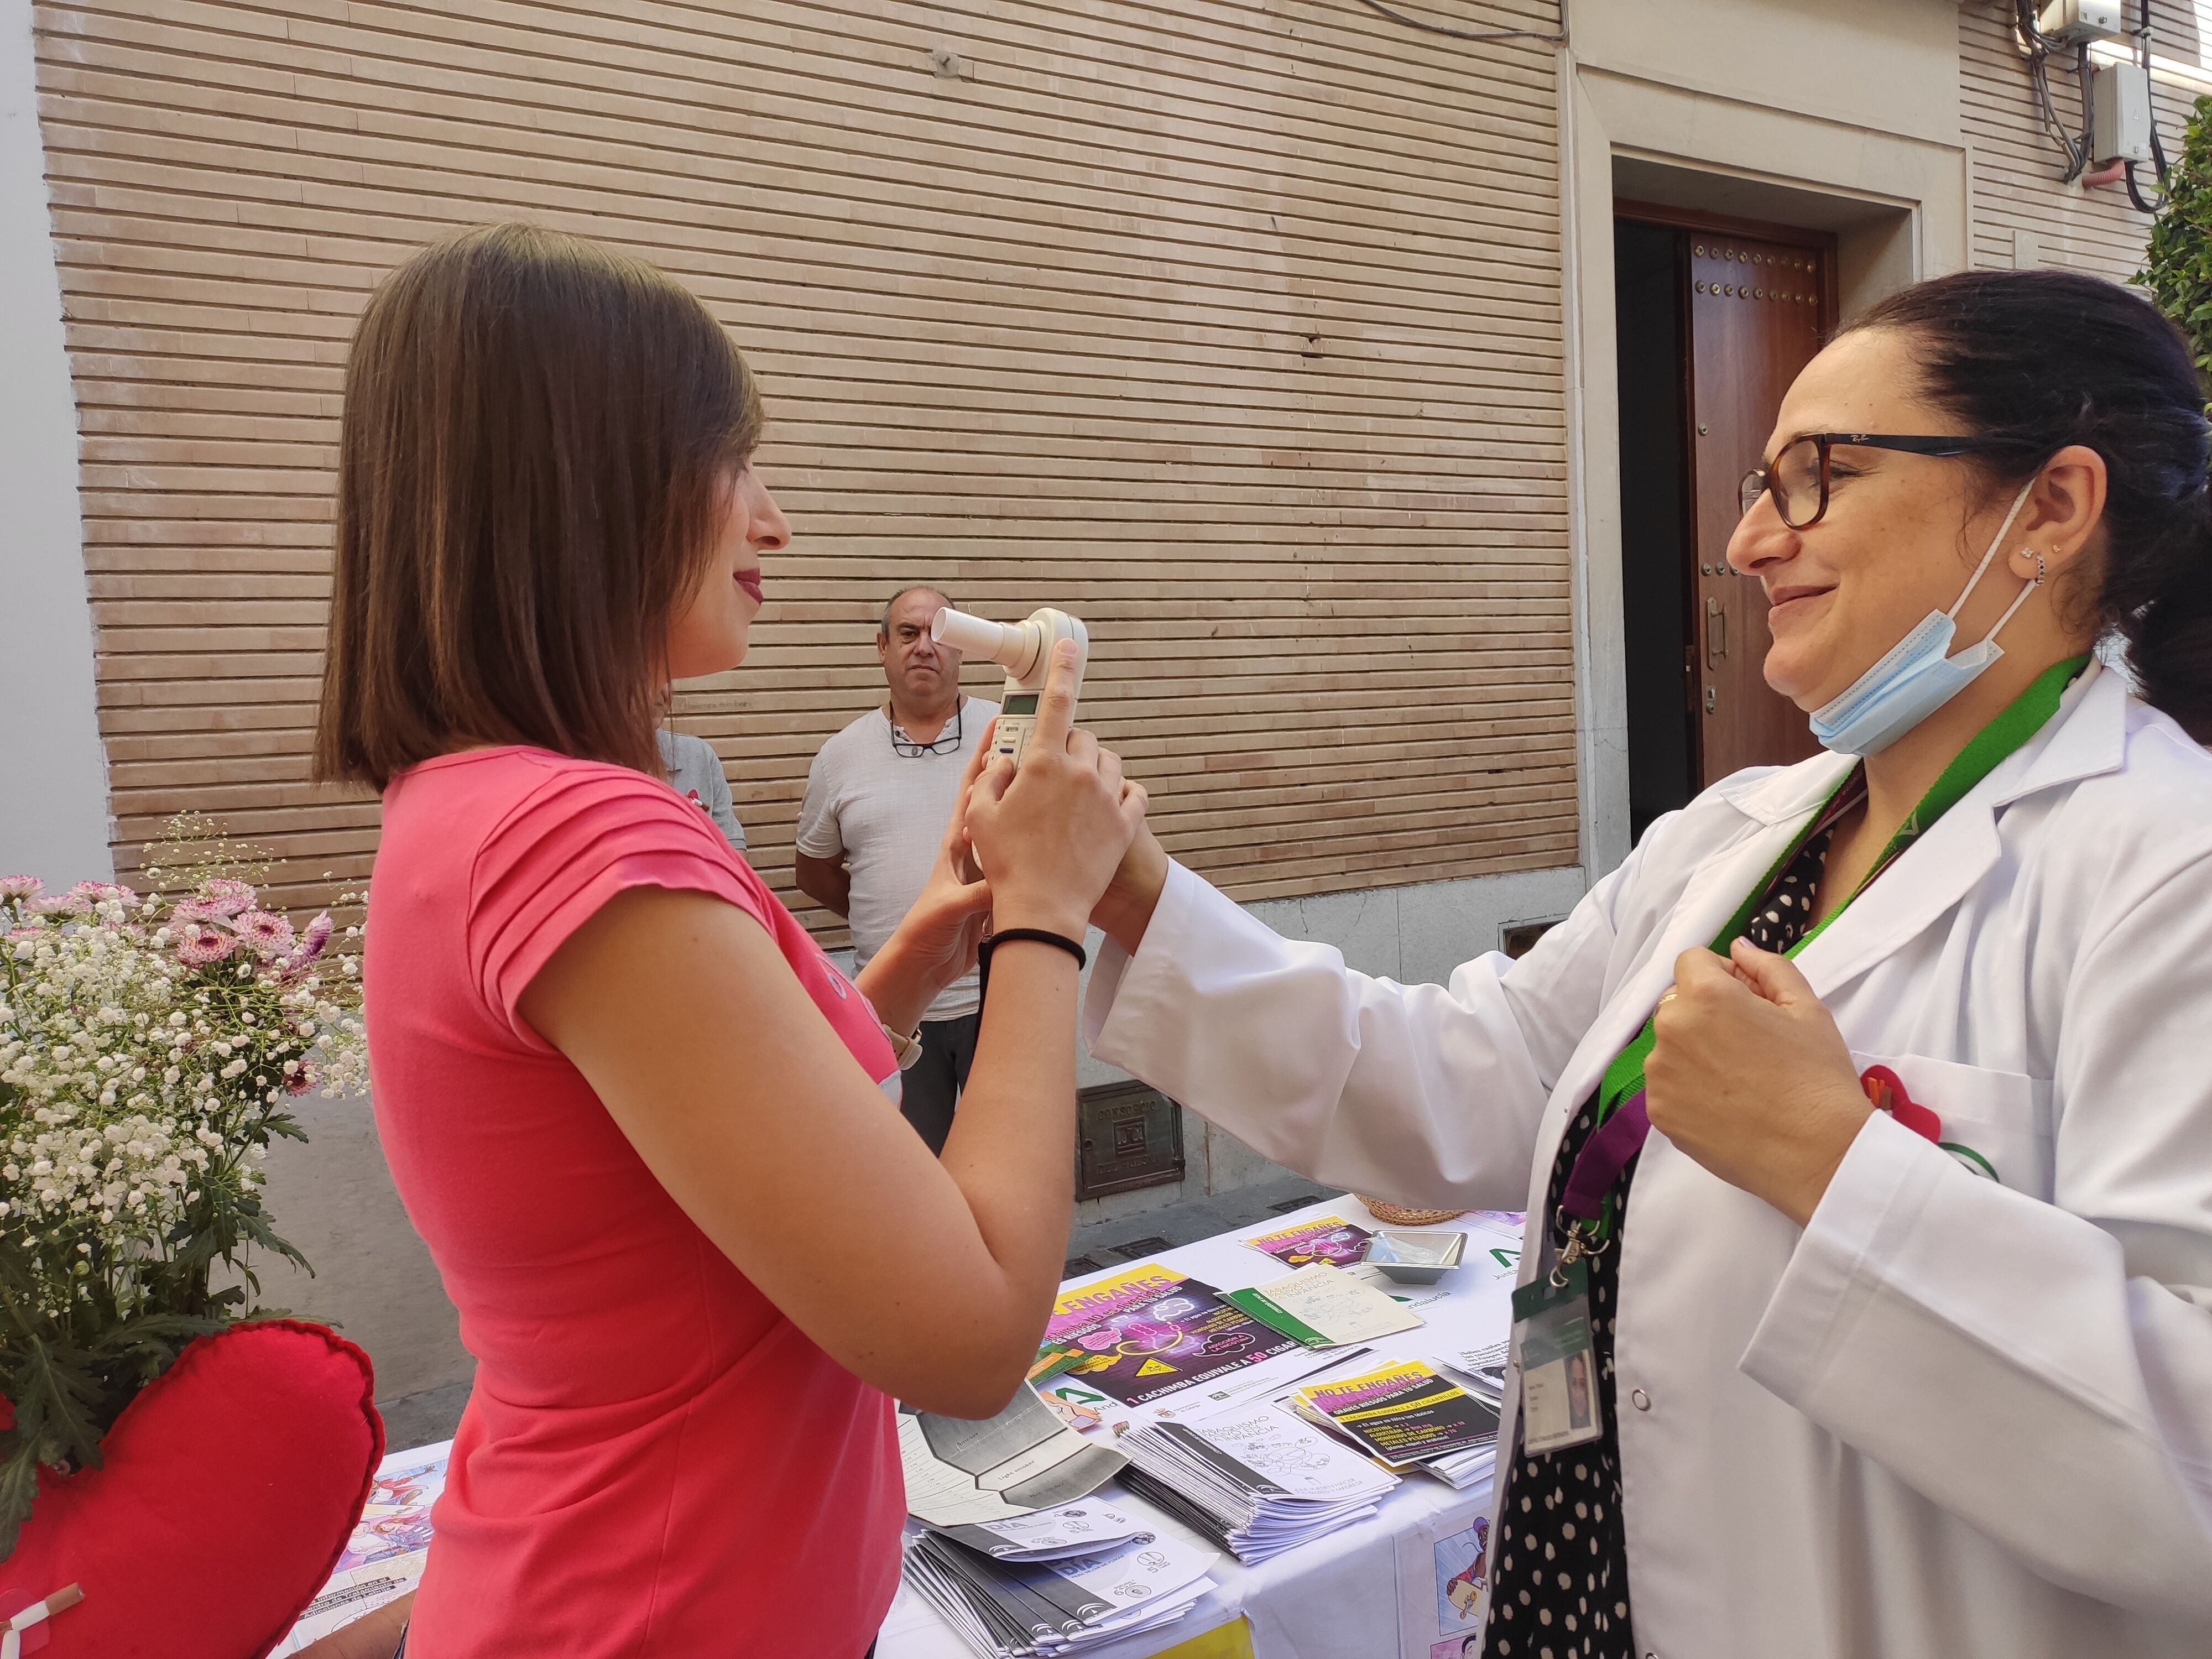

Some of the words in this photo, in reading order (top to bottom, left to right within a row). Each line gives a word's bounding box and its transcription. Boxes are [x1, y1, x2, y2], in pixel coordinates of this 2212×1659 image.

[1493, 1270, 1519, 1280] Junta
[1084, 1313, 1103, 1325] NO
[1116, 1288, 1162, 1309] divertida
[1407, 1292, 1452, 1310] ndalucía
[1066, 1323, 1102, 1341] RIESGOS
[1123, 1302, 1147, 1313] PARA
[1155, 1286, 1182, 1300] SALUD
[1137, 1380, 1197, 1402] CACHIMBA
[1196, 1363, 1239, 1383] EQUIVALE
[1246, 1352, 1269, 1363] 50
[1313, 1389, 1335, 1398] NO
[1339, 1386, 1354, 1395] TE
[1355, 1371, 1423, 1392] ENGAÑES
[1333, 1404, 1360, 1415] GRAVES
[1359, 1396, 1388, 1408] RIESGOS
[1386, 1390, 1406, 1400] PARA
[1411, 1379, 1434, 1390] SALUD
[1422, 1391, 1460, 1405] CIGARRILLOS
[1194, 1416, 1269, 1437] TABAQUISMO
[1221, 1425, 1279, 1442] INFANCIA
[957, 1432, 979, 1447] Smoker
[998, 1472, 1014, 1480] Light
[1014, 1460, 1035, 1473] smoker
[1057, 1558, 1103, 1576] DÍA
[304, 1600, 351, 1619] Adicciones
